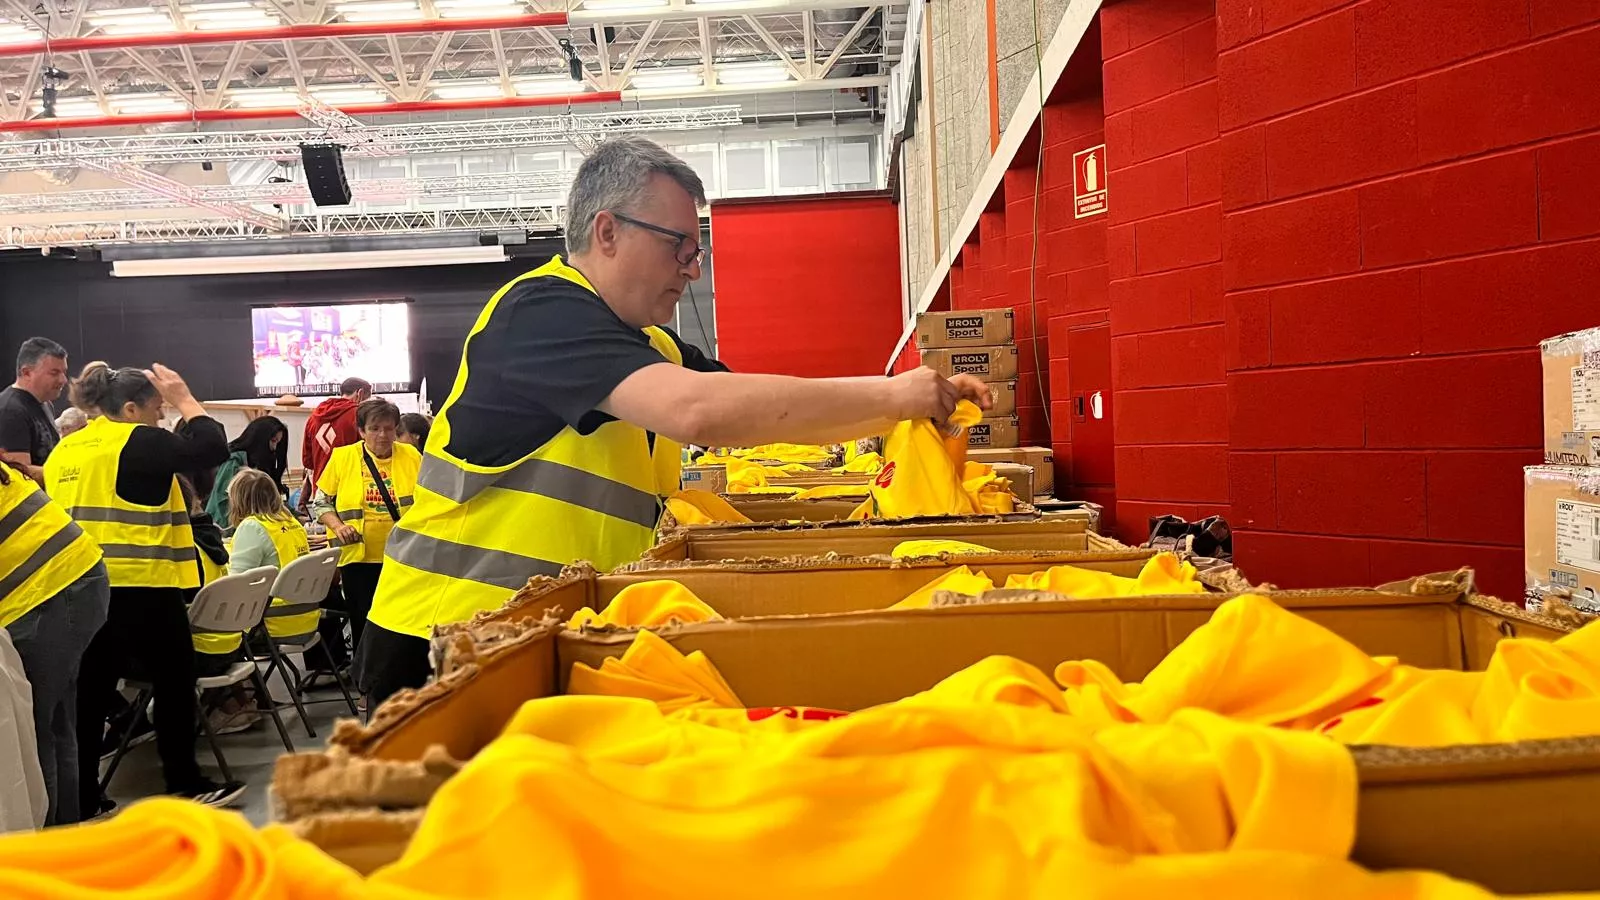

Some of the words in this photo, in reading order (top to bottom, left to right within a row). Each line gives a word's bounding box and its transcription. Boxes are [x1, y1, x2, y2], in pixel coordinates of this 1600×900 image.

[955, 319, 981, 327] ROLY
[948, 328, 982, 338] Sport.
[961, 355, 987, 363] ROLY
[954, 365, 988, 373] Sport.
